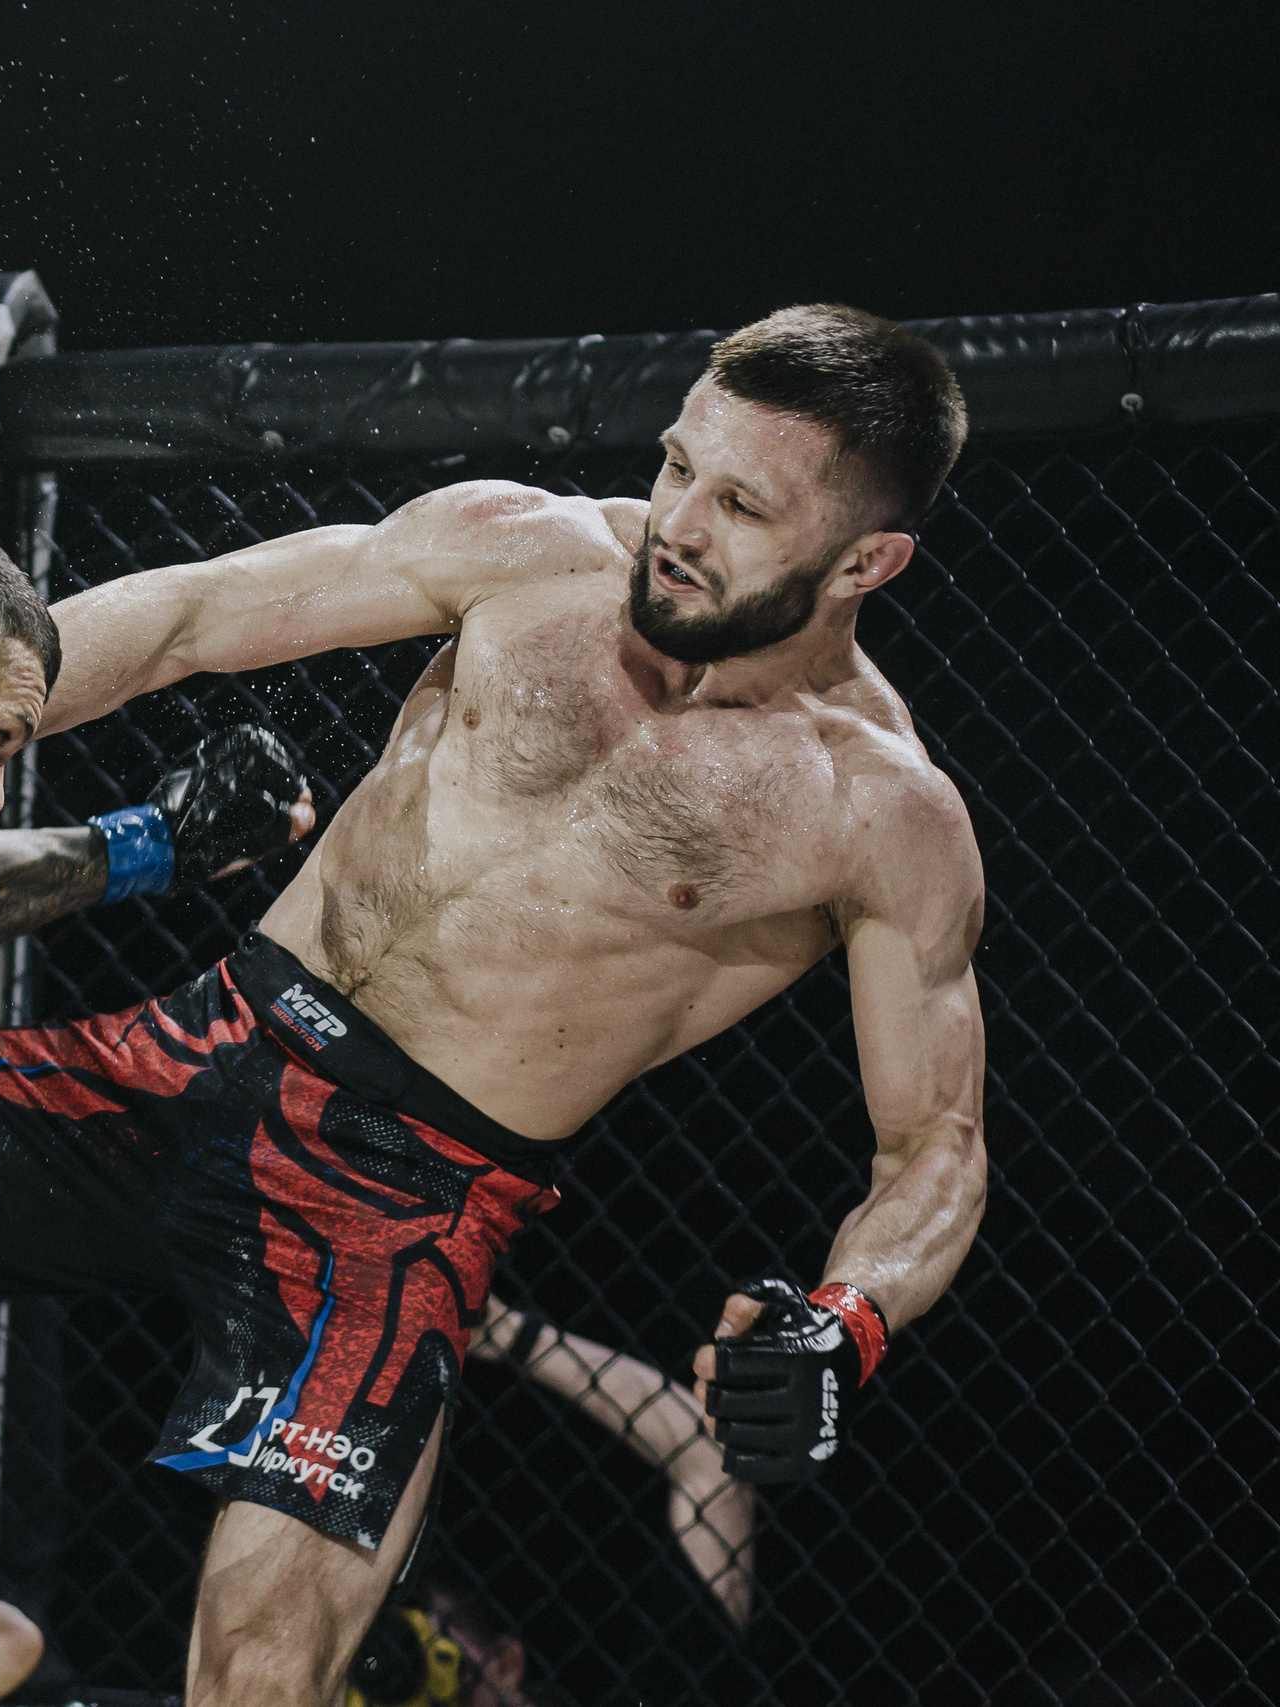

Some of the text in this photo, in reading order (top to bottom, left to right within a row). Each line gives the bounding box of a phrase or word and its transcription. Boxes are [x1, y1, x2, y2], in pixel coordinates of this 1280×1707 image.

[280, 983, 348, 1037] MFP
[268, 1417, 376, 1472] РТ-НЭО
[253, 1445, 365, 1500] Иркутск
